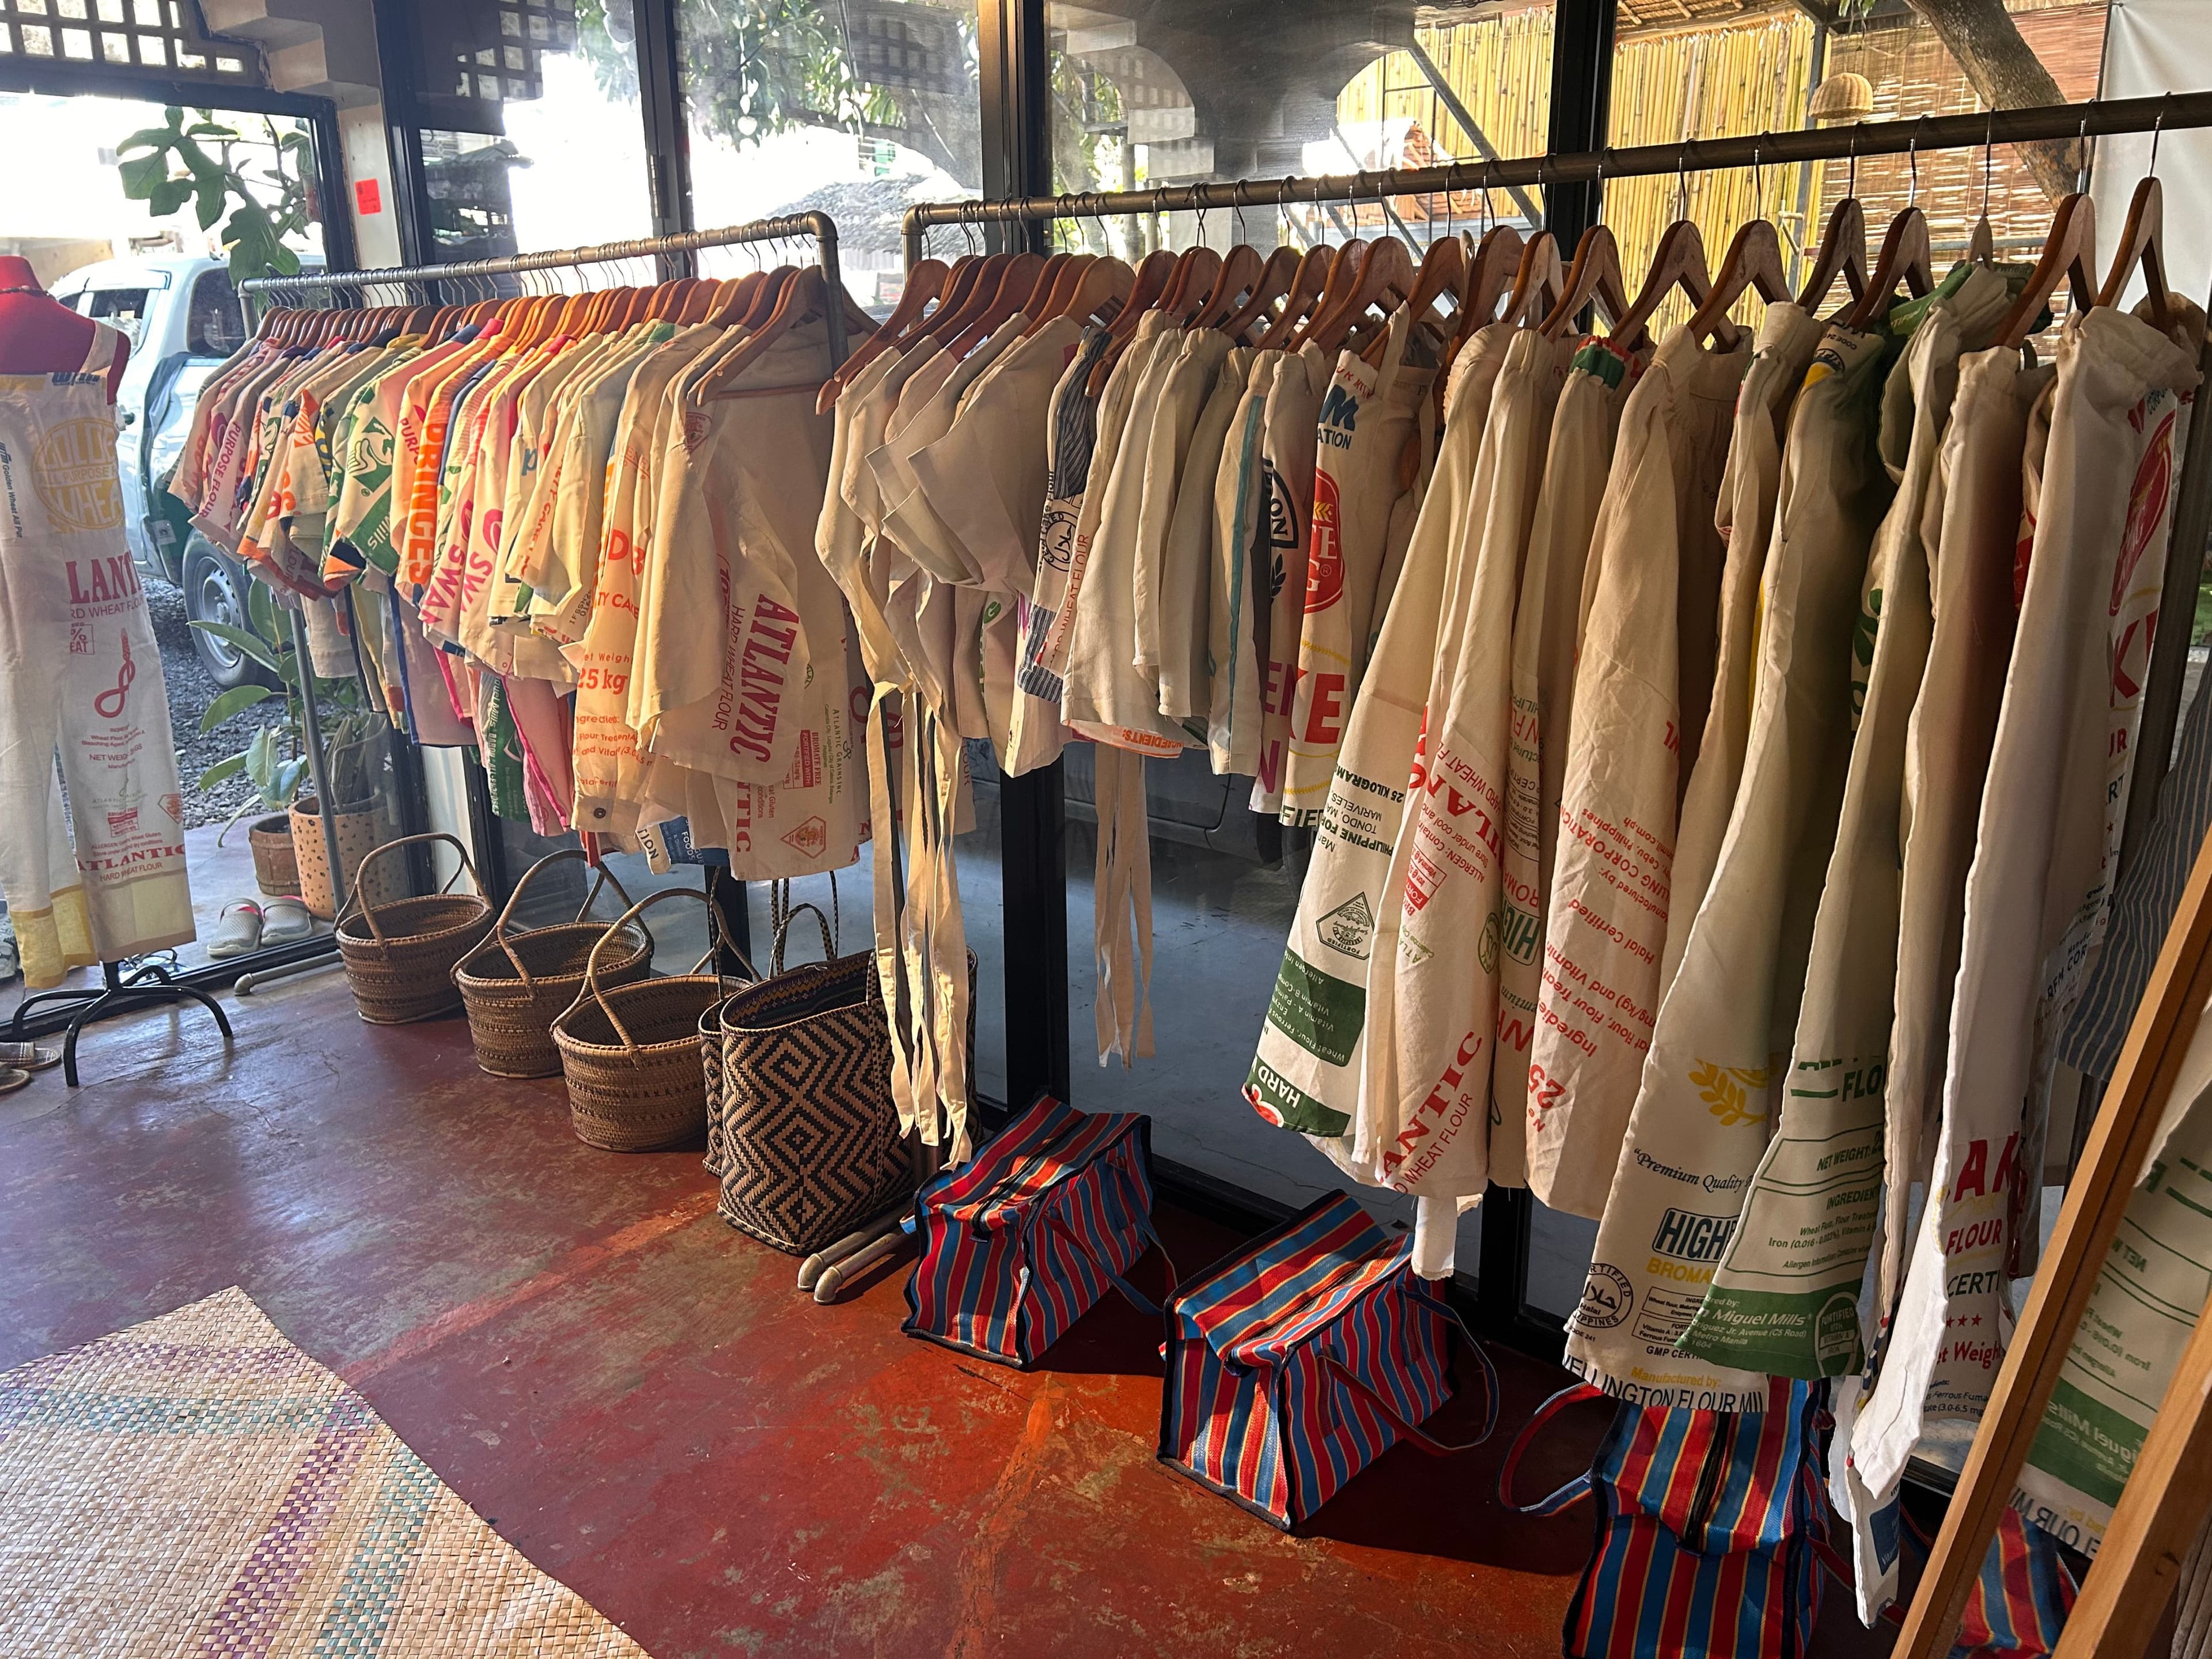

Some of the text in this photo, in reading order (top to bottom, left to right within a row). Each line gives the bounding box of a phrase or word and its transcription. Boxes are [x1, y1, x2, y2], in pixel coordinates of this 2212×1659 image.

[64, 468, 109, 482] PURPOSE
[199, 421, 241, 518] PURPOSE FLOUR
[3, 465, 12, 493] Golden
[9, 492, 18, 513] Wheat
[89, 603, 124, 618] WHEAT
[599, 652, 633, 664] Weigh
[713, 605, 745, 730] HARD WHEAT FLOUR
[603, 668, 628, 695] kg
[730, 594, 800, 763] ATLANTIC
[832, 709, 841, 748] ATLANTIC
[812, 732, 821, 763] BROMATE
[1335, 764, 1404, 803] 25 KILOGRAM
[1445, 756, 1487, 795] WHEAT
[1341, 810, 1377, 835] TONDO,
[1433, 817, 1453, 835] cool
[681, 831, 695, 861] FOODS
[1339, 828, 1394, 857] PHILIPPINE
[1452, 832, 1475, 853] under
[1582, 808, 1660, 870] Cebu, Philippines
[1445, 847, 1485, 883] ALLERGEN:
[1475, 850, 1488, 868] Store
[100, 869, 120, 881] HARD
[139, 862, 163, 873] FLOUR
[1599, 867, 1617, 885] by:
[1568, 899, 1656, 965] Halal Certified
[1327, 938, 1360, 954] FORTIFIED
[1296, 961, 1324, 985] Allergen
[1543, 967, 1572, 1002] Treat
[1588, 980, 1616, 1001] and
[1301, 995, 1329, 1016] Vitamin
[1573, 997, 1604, 1024] Flour
[1272, 1012, 1295, 1034] Ferrous
[1305, 1012, 1334, 1032] Vitamin
[1539, 1001, 1598, 1058] Ingredie
[1317, 1046, 1345, 1063] Wheat
[1257, 1065, 1301, 1108] HARD
[1382, 1031, 1482, 1179] ANTIC
[1402, 1093, 1473, 1185] WHEAT FLOUR
[1817, 1154, 1833, 1171] NET
[1703, 1174, 1745, 1193] Quality
[1768, 1237, 1787, 1248] Iron
[1946, 1218, 2001, 1256] FLOUR
[1647, 1257, 1713, 1284] BROMA
[1783, 1259, 1810, 1270] Allergen
[1580, 1302, 1601, 1315] Halal
[1648, 1296, 1664, 1305] Wheat
[1726, 1298, 1740, 1308] by:
[1713, 1308, 1806, 1326] Miguel Mills
[1585, 1334, 1596, 1342] 241
[1639, 1330, 1662, 1342] Ferrous
[1643, 1323, 1664, 1335] Vitamin
[1692, 1331, 1748, 1346] Metro Manila
[1739, 1329, 1768, 1337] Avenue
[1783, 1330, 1807, 1339] Road)
[1646, 1345, 1669, 1356] GMP
[1631, 1366, 1707, 1385] Manufactured
[1935, 1390, 1963, 1399] Ferrous
